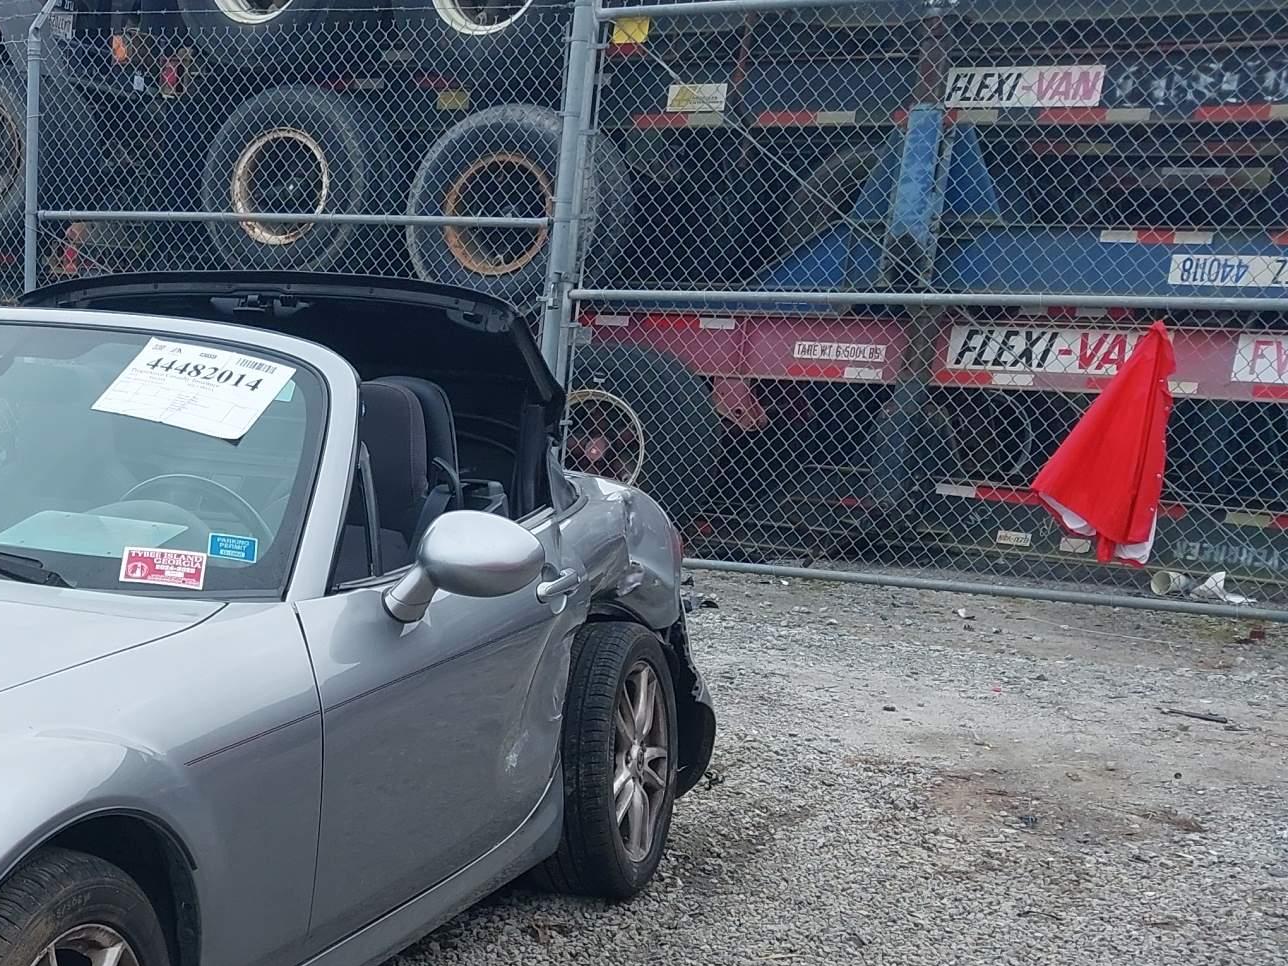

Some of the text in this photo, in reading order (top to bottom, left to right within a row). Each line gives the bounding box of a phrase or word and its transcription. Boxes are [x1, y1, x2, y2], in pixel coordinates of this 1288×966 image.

[945, 71, 1101, 102] FLEXI-VAN
[1180, 257, 1249, 284] 440118
[797, 343, 818, 356] TARE
[954, 329, 1145, 371] FLEXI-VA
[146, 357, 264, 392] 44482014
[153, 558, 202, 569] GEORGIA
[163, 552, 203, 561] ISLAND
